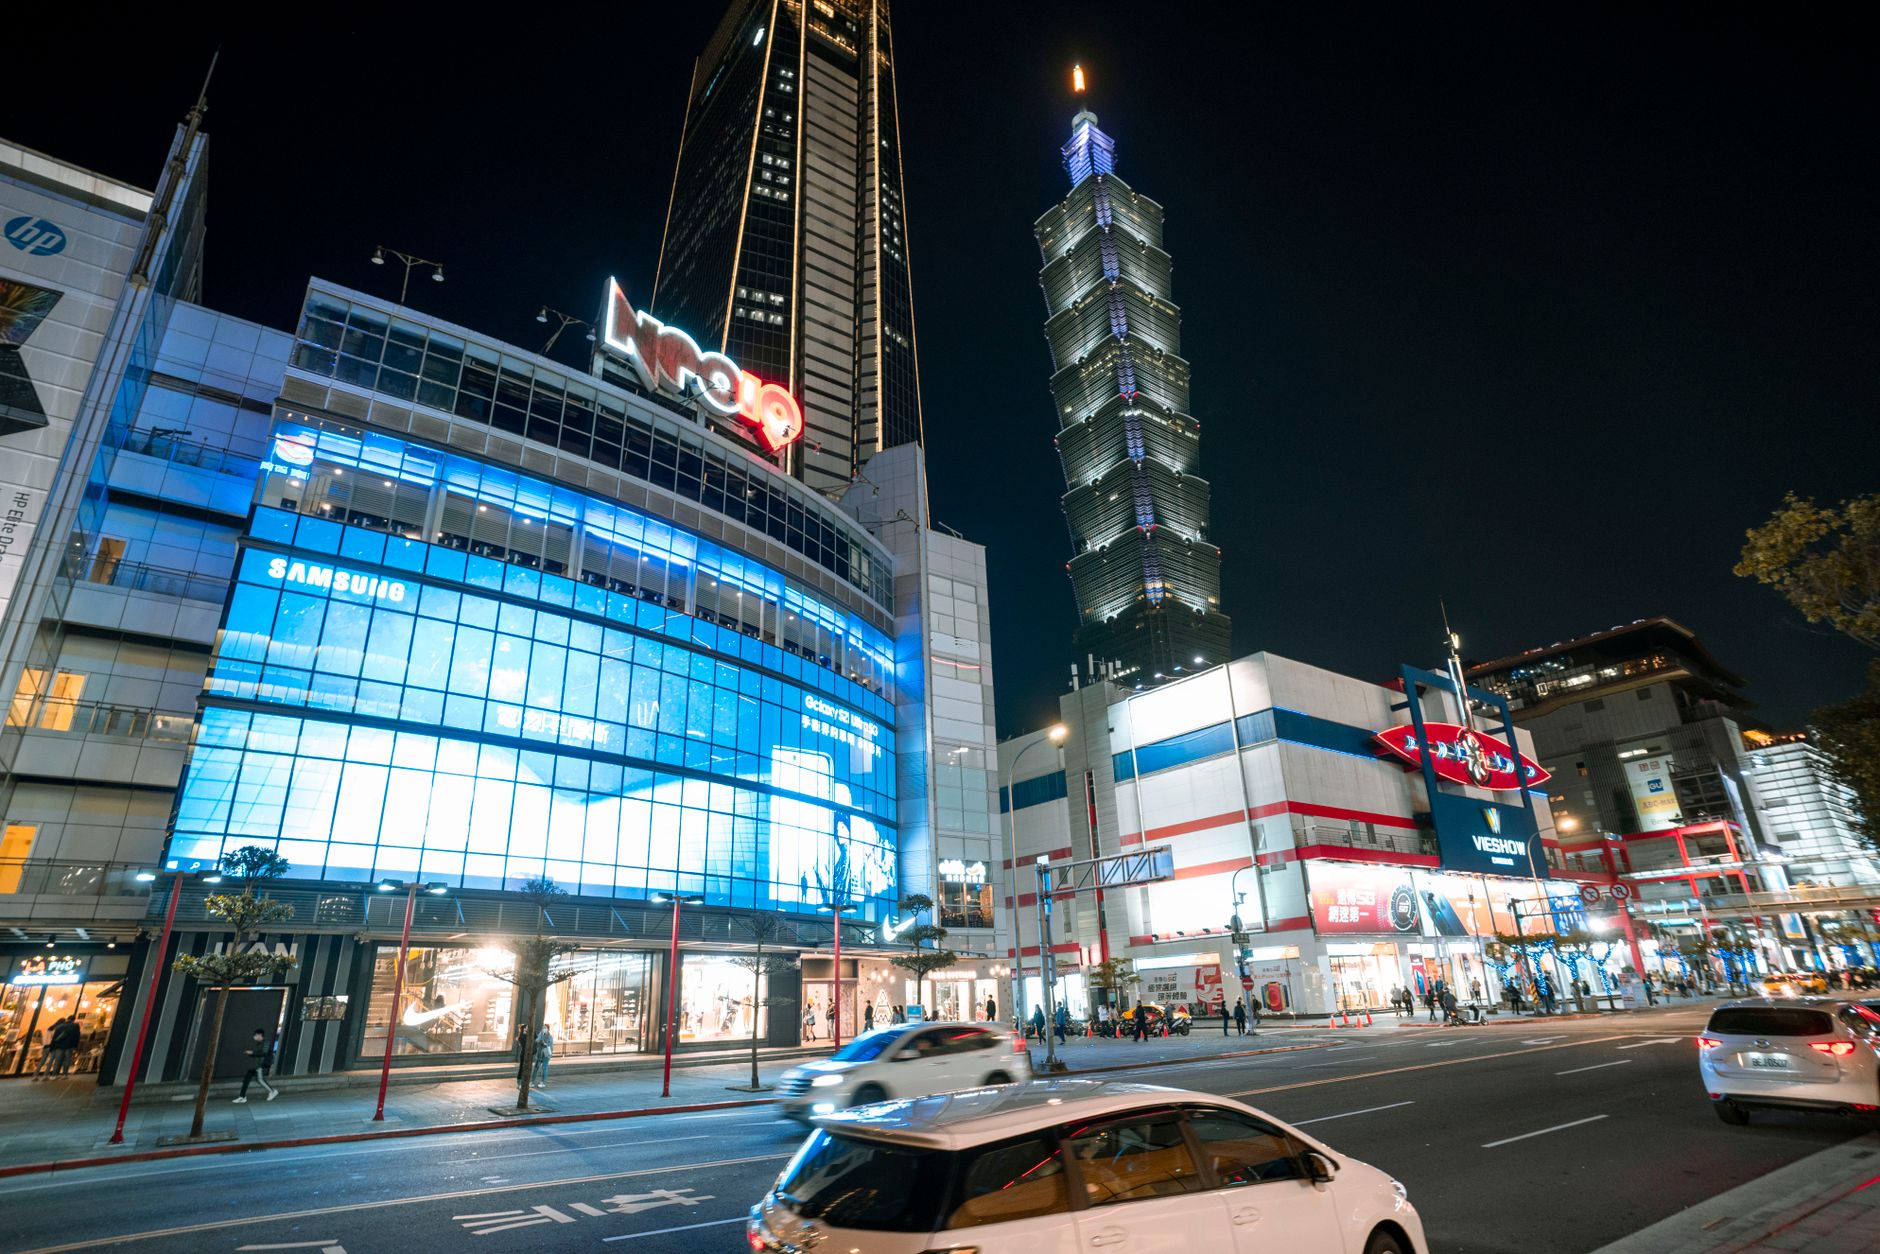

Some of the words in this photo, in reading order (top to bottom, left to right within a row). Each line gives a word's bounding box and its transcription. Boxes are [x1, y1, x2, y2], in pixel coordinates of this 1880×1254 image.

[8, 217, 63, 255] hp
[12, 491, 31, 508] HP
[1, 509, 24, 534] Elite
[268, 558, 406, 602] SAMSUNG
[804, 695, 839, 720] Galaxy
[1471, 835, 1526, 856] VIESHOW
